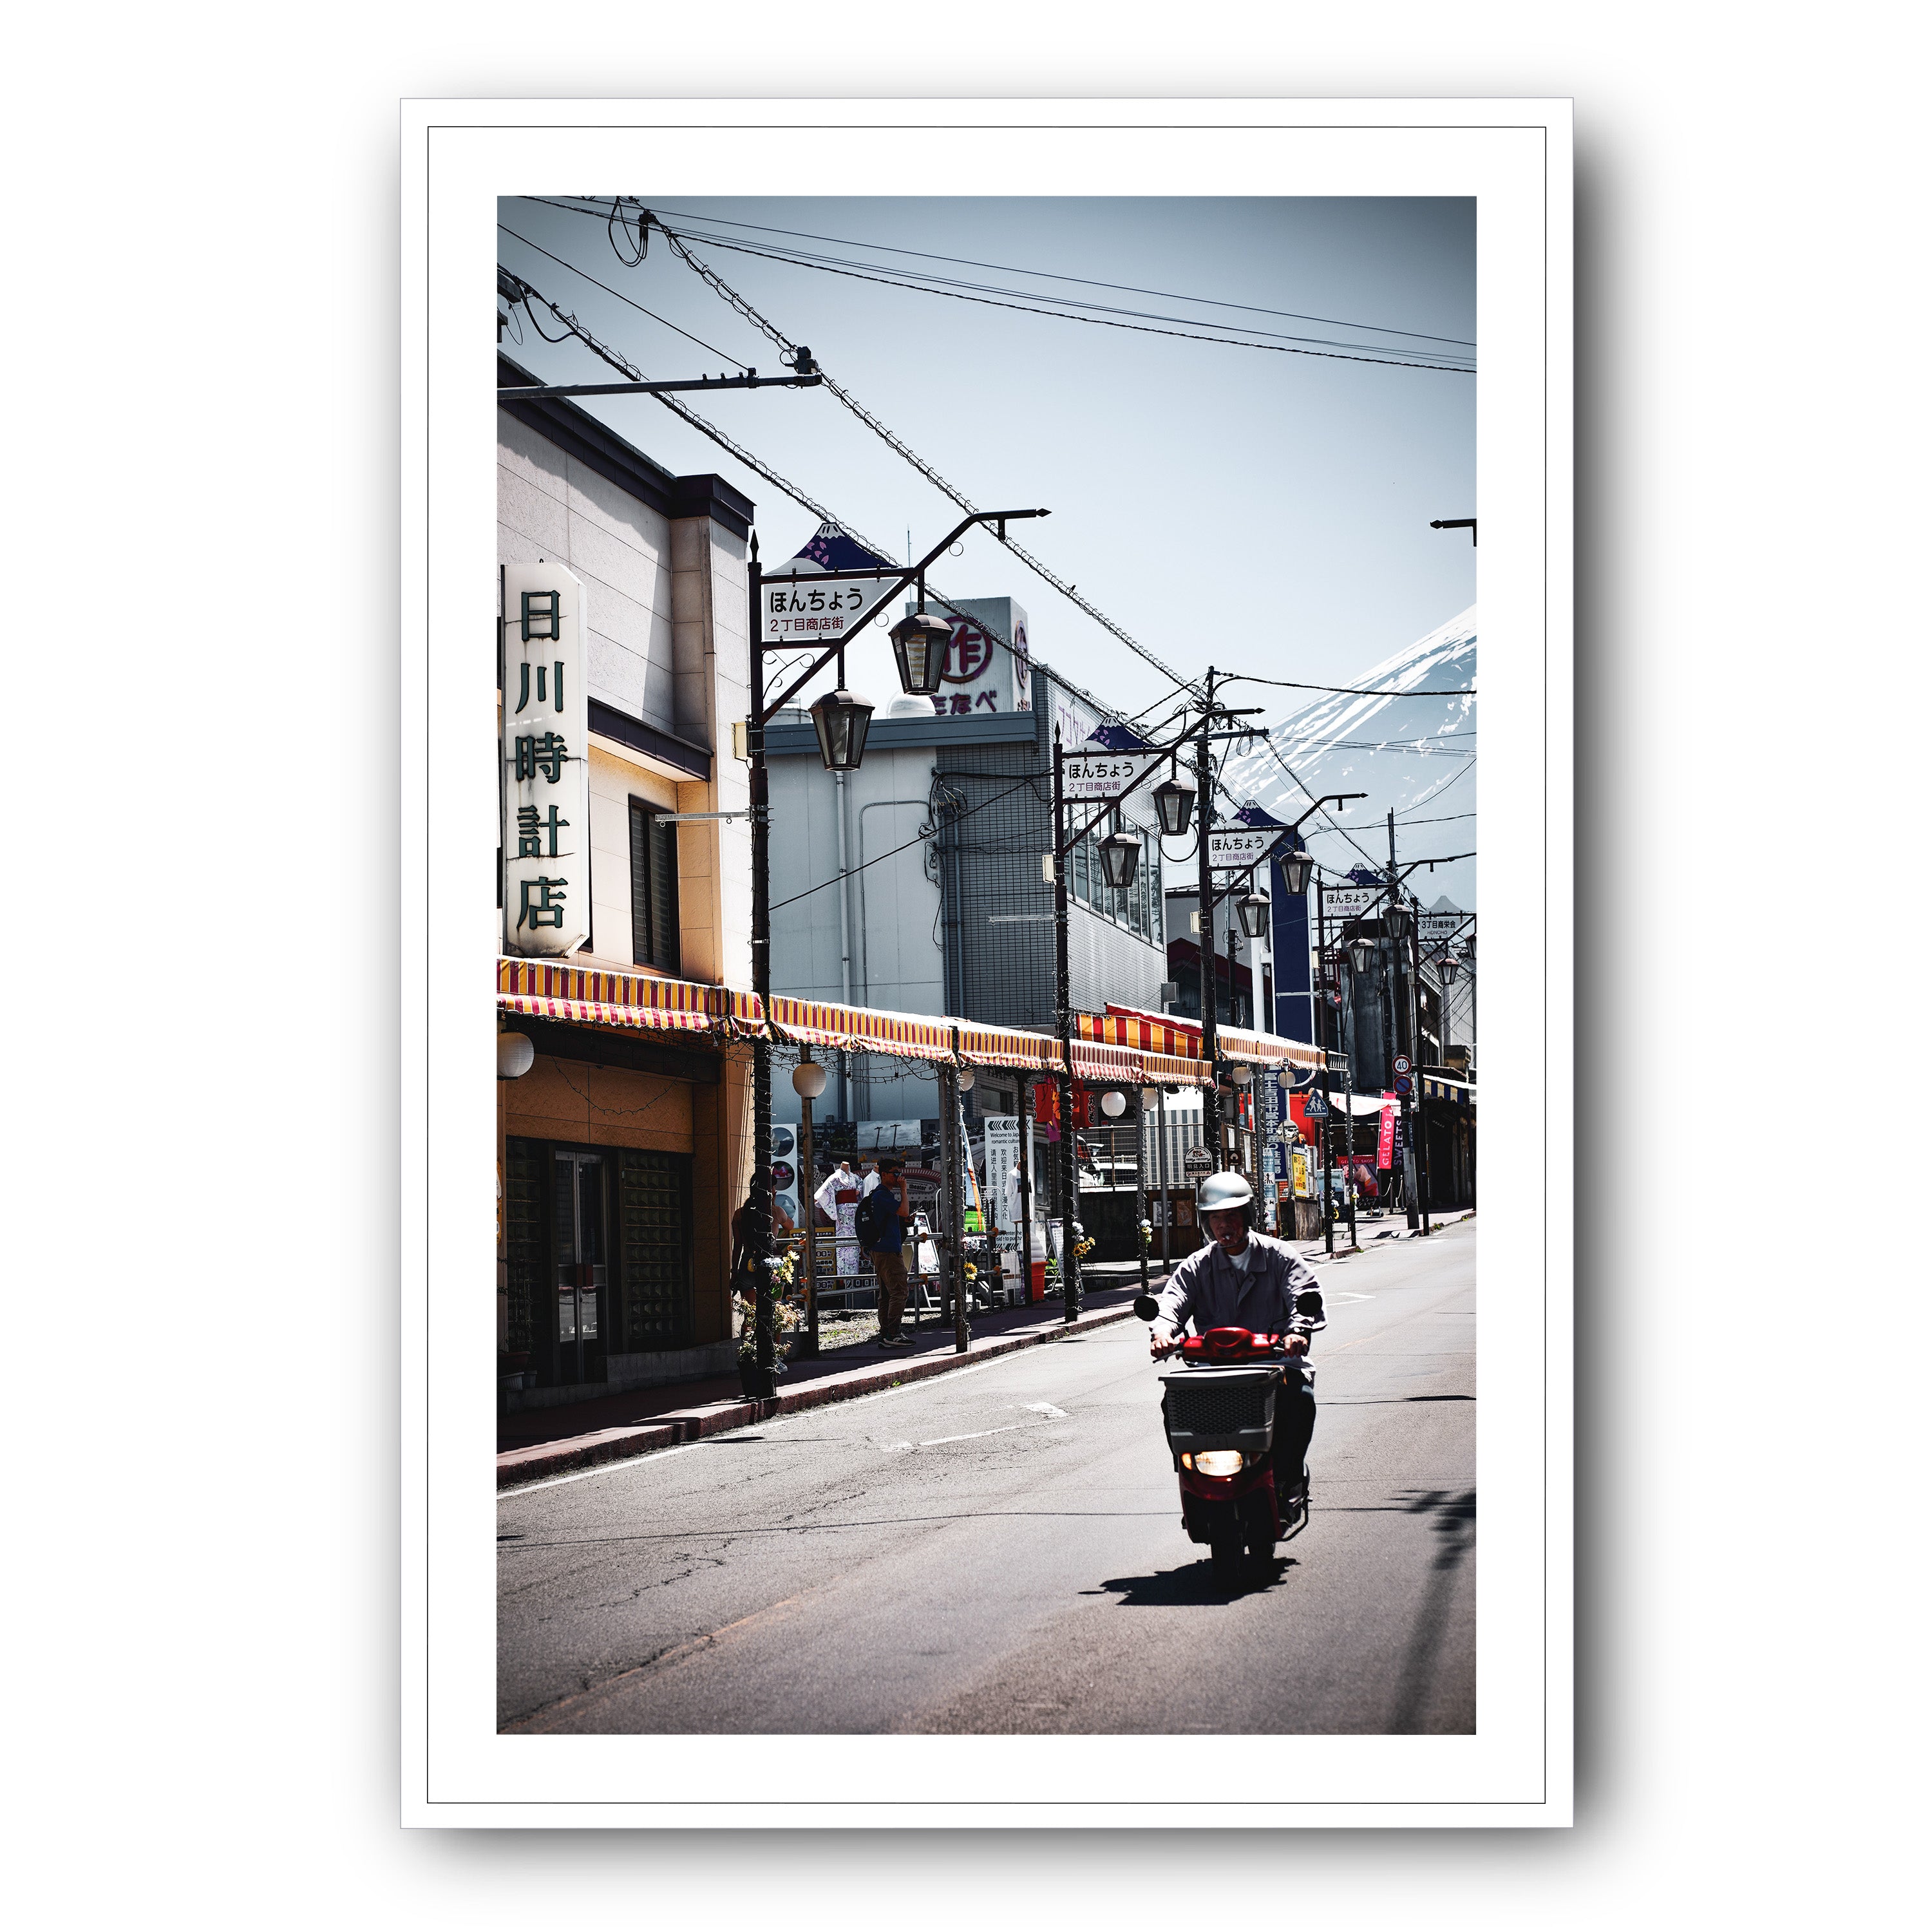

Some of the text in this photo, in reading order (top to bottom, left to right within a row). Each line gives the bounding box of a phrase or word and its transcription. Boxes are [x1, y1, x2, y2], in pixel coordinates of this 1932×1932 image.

[770, 587, 863, 613] ほんちょう
[770, 616, 844, 632] 2丁目商店街
[515, 589, 571, 930] 日川時計店
[1069, 761, 1134, 779] ほんちょう
[1069, 781, 1121, 792] 2丁目商店街
[1212, 836, 1264, 851] ほんちょう
[1212, 852, 1254, 862] 2丁目商店街
[1327, 892, 1370, 904] ほんちょう
[1421, 920, 1456, 929] 3丁目商栄会
[1397, 1061, 1408, 1070] 40
[1382, 1121, 1392, 1166] GELATO
[1394, 1120, 1403, 1166] SWEETS
